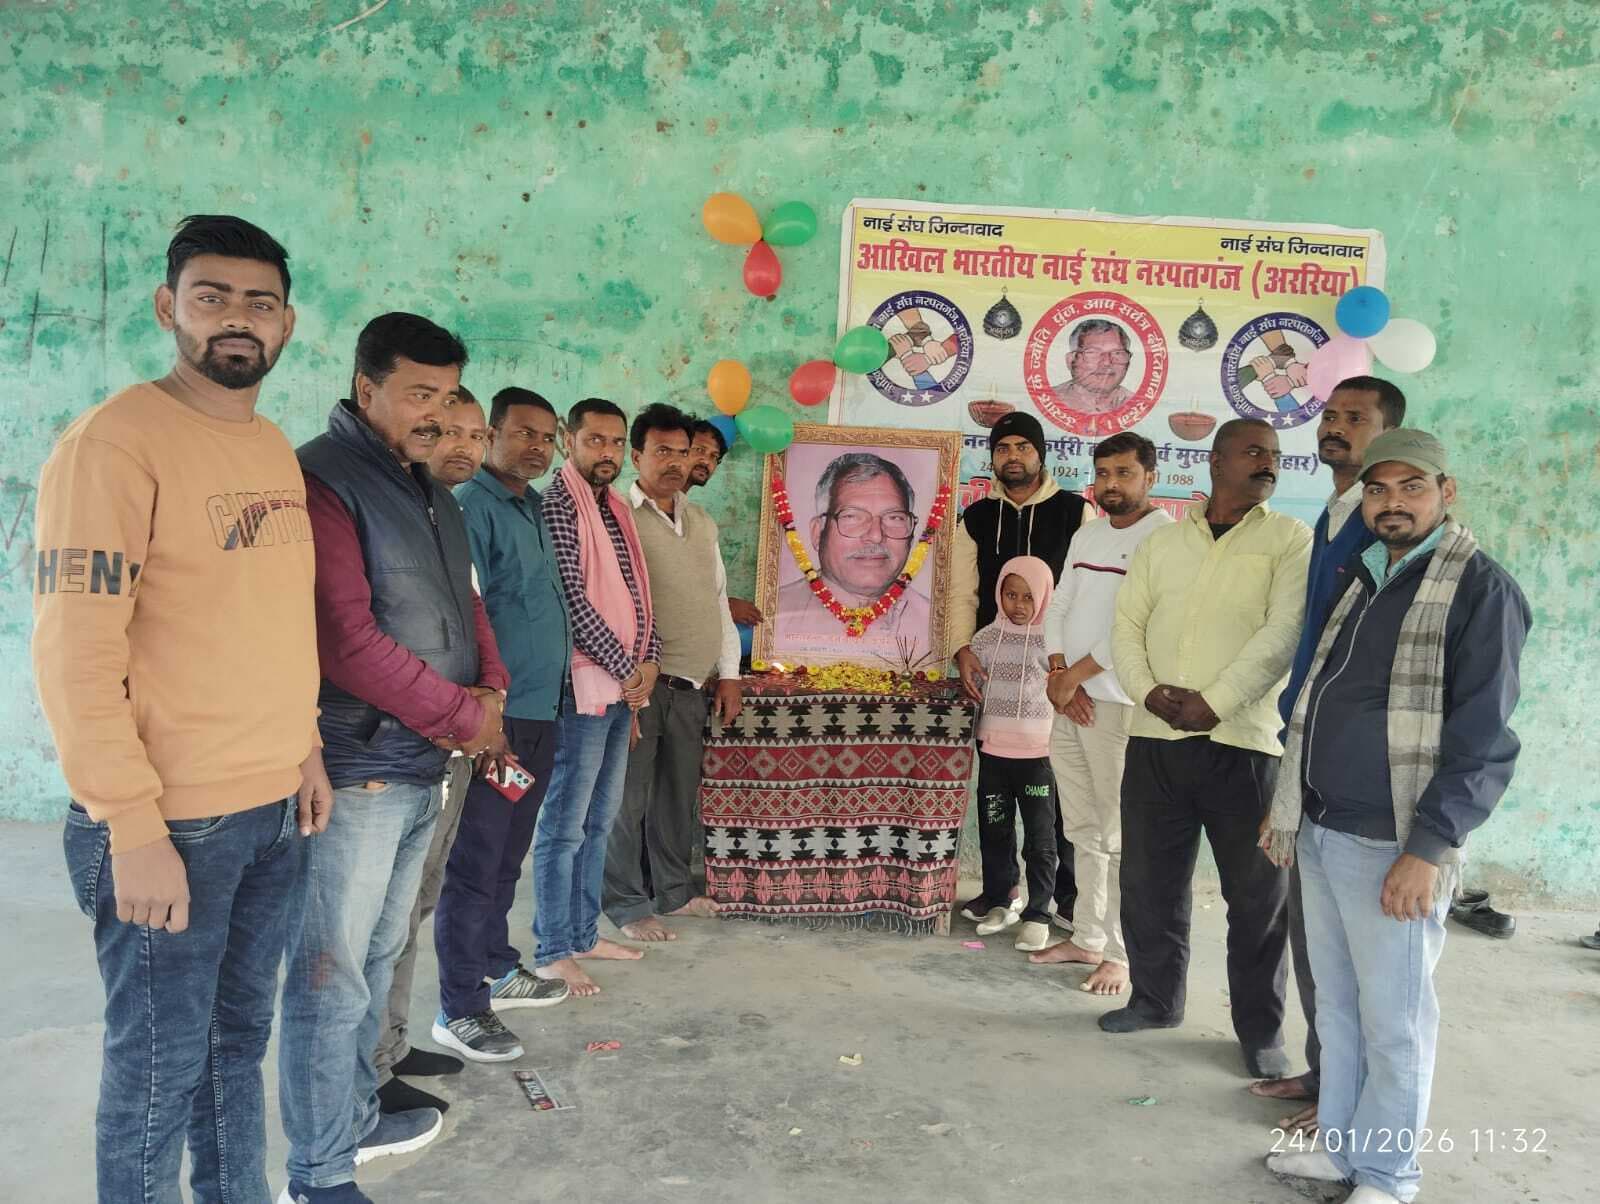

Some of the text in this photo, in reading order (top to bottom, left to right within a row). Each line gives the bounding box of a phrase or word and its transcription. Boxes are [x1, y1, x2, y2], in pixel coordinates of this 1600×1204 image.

[863, 213, 1004, 237] नाई संघ जिन्दावाद
[1220, 234, 1366, 259] नाई संघ जिन्दावाद
[953, 244, 1037, 279] भारतीय
[1041, 247, 1087, 286] नाई
[1091, 249, 1131, 285] संघ
[1135, 256, 1243, 291] नरपतगंज
[1083, 298, 1117, 310] आप
[1053, 466, 1080, 478] 1924
[1167, 474, 1194, 486] 1988
[1025, 784, 1050, 797] CHANGE
